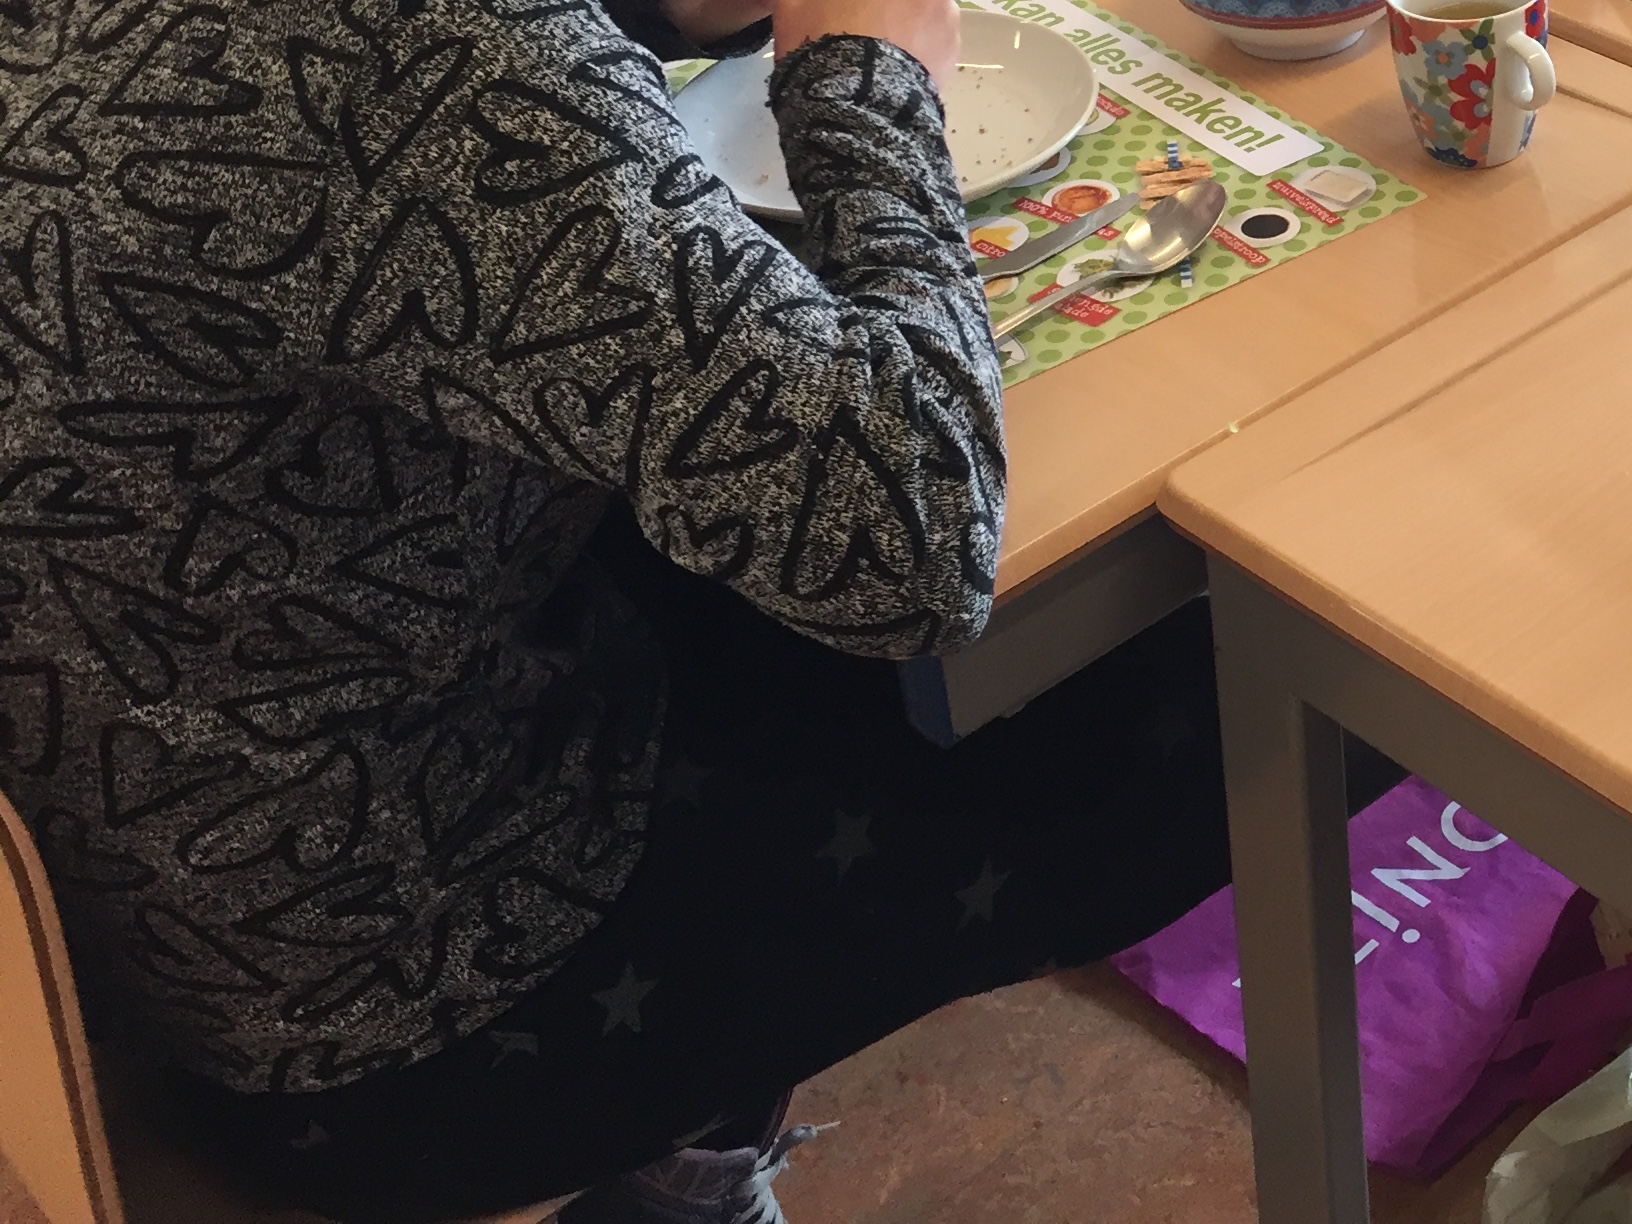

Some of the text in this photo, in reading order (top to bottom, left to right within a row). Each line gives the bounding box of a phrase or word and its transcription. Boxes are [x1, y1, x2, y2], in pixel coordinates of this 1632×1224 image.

[1063, 28, 1143, 75] alles
[1131, 72, 1285, 153] maken!
[975, 242, 1007, 258] citro
